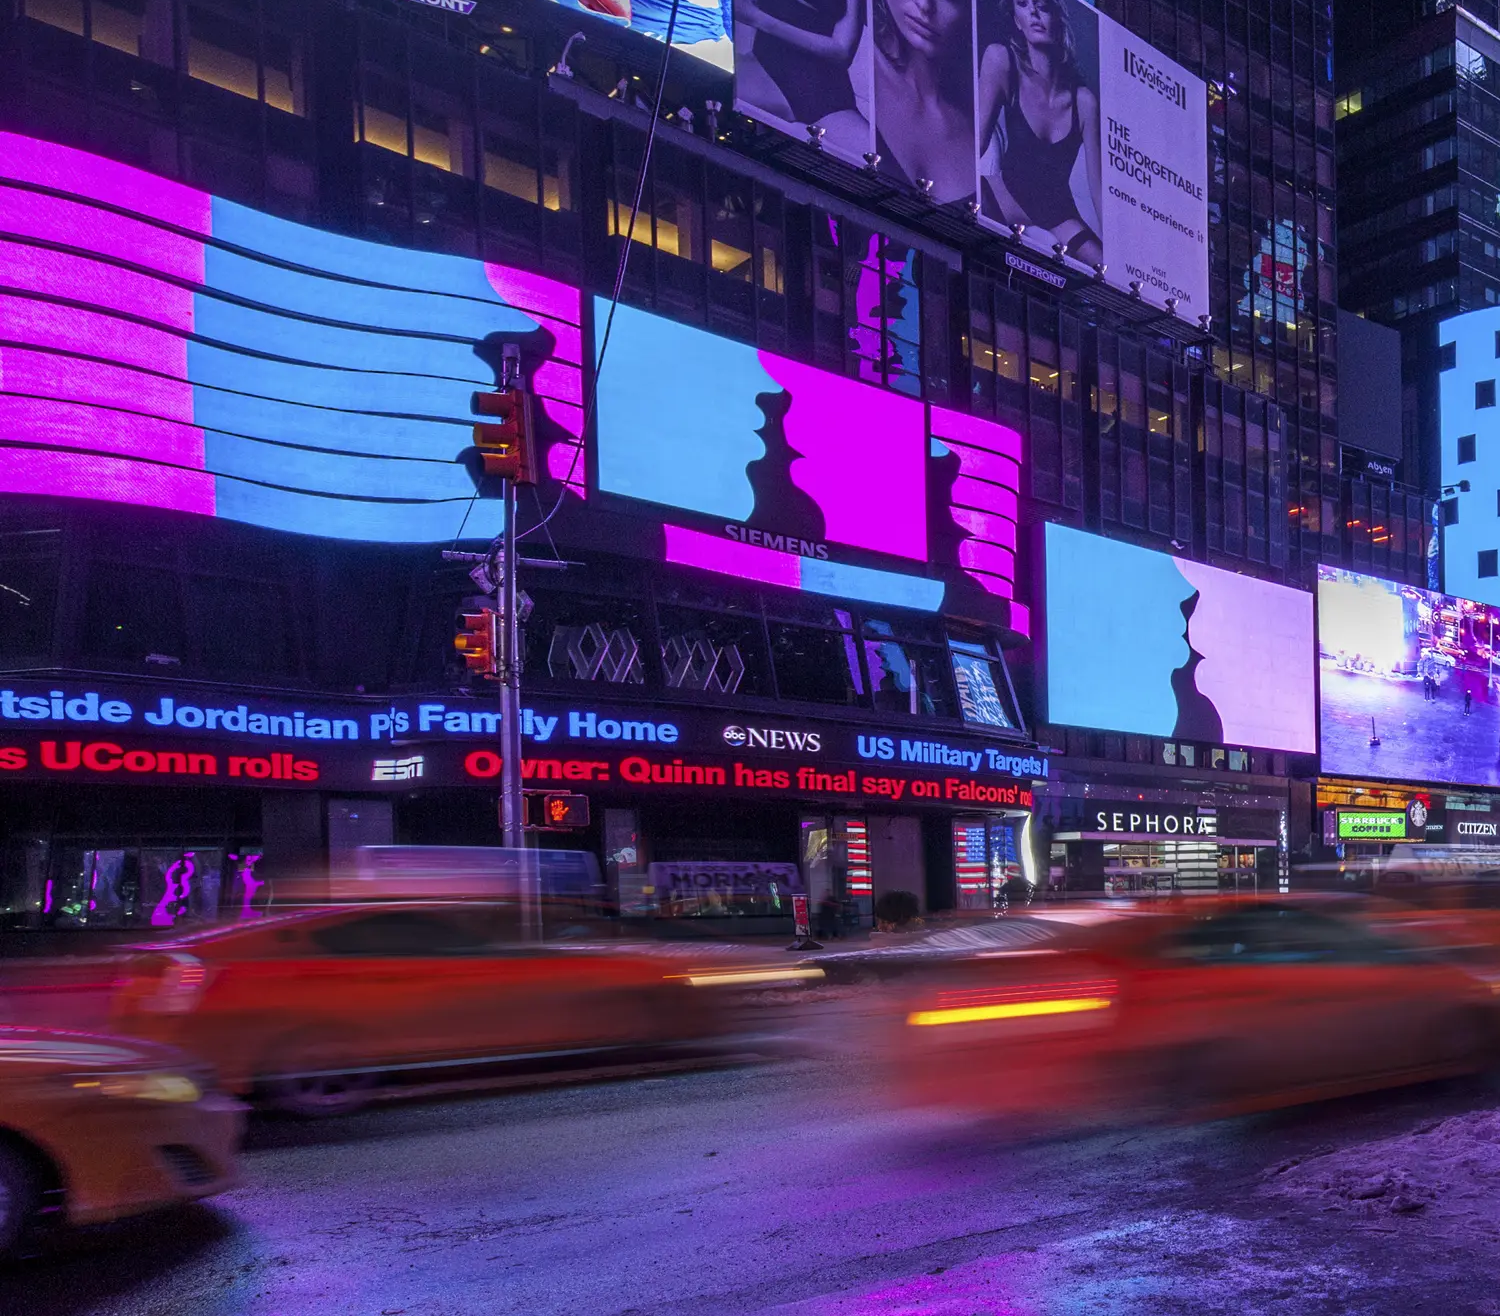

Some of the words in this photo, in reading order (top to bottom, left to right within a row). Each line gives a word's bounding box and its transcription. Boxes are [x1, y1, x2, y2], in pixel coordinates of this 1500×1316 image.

[1135, 60, 1176, 97] Wolford
[1107, 117, 1130, 142] THE
[1108, 135, 1203, 201] UNFORGETTABLE
[1108, 151, 1152, 188] TOUCH
[1108, 185, 1137, 207] come
[1140, 201, 1194, 239] experience
[1197, 230, 1204, 244] it
[1009, 256, 1062, 286] OUTFRONT
[1125, 263, 1191, 304] WOLFORD.COM
[1151, 265, 1166, 278] VISIT
[725, 524, 829, 560] SIEMENS
[144, 698, 358, 740] Jordanian
[569, 712, 679, 743] Home
[747, 727, 821, 752] NEWS
[857, 735, 895, 760] US
[900, 740, 982, 772] Military
[985, 749, 1041, 777] Targets
[40, 740, 217, 775] UConn
[228, 752, 319, 781] rolls
[619, 756, 725, 785] Quinn
[735, 763, 790, 788] has
[796, 768, 856, 793] final
[862, 776, 905, 800] say
[911, 779, 940, 798] on
[945, 778, 1018, 805] Falcons'
[1097, 812, 1209, 834] SEPHORA
[1457, 822, 1497, 835] CITIZEN
